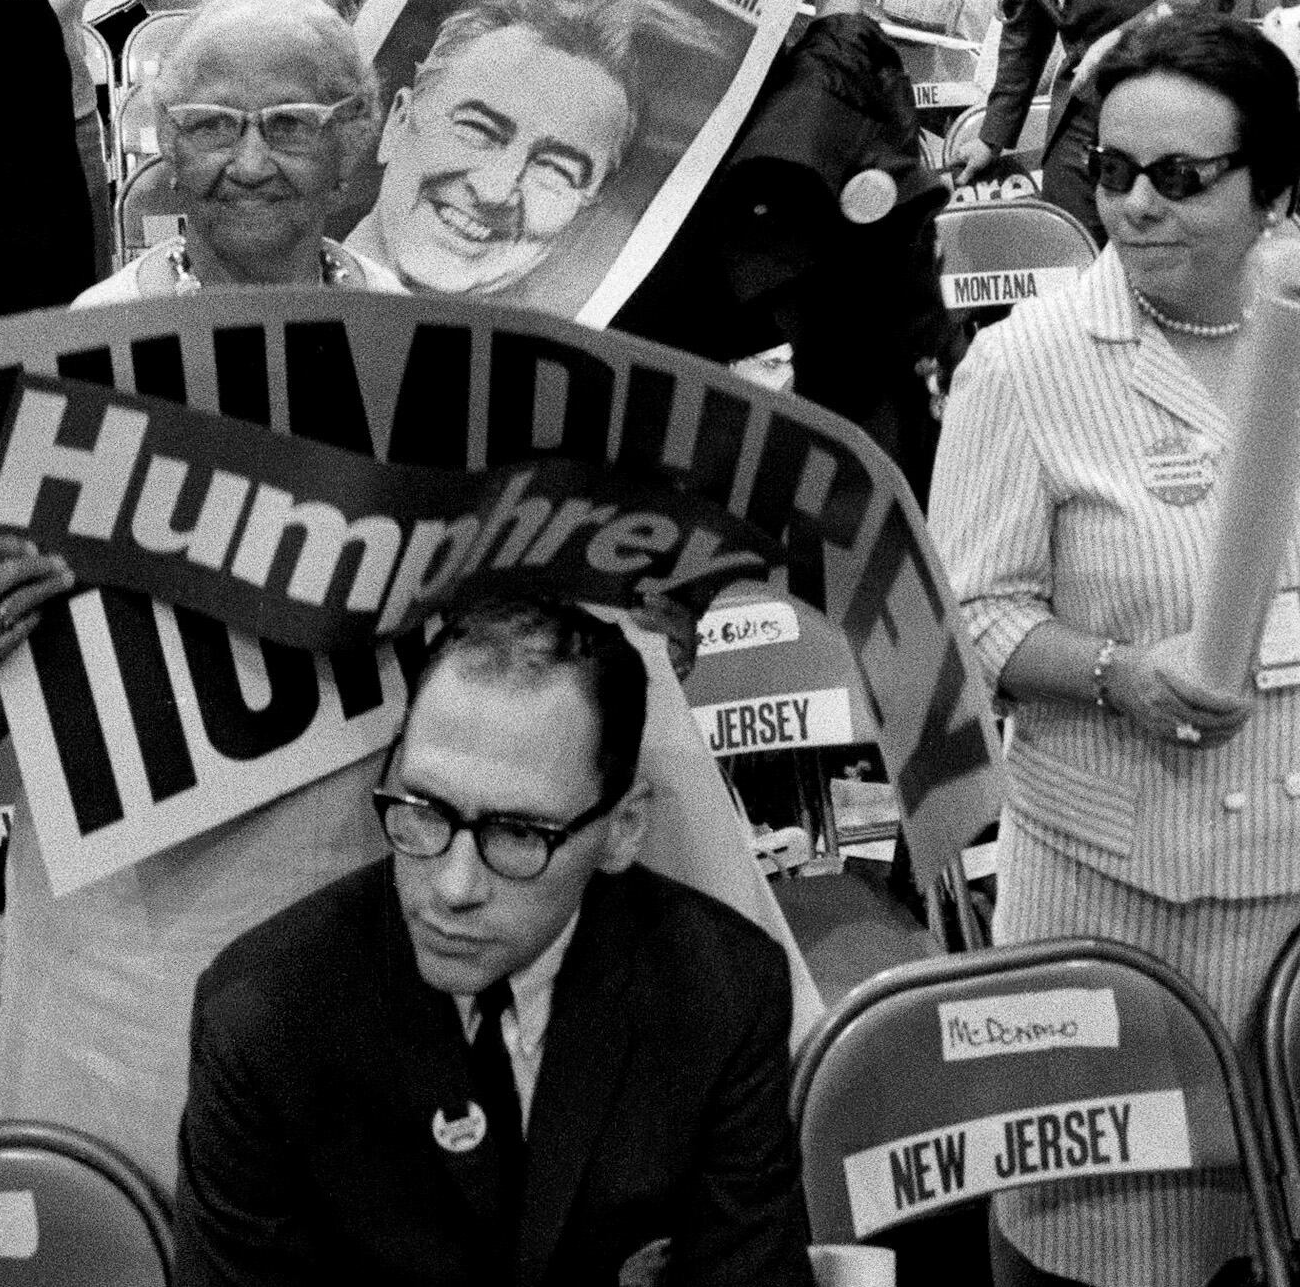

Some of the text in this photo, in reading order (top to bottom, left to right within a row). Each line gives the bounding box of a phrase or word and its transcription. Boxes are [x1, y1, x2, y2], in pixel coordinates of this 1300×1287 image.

[953, 272, 1038, 304] MONTANA
[710, 698, 809, 752] JERSEY
[889, 1102, 1133, 1211] NEW JERSEY
